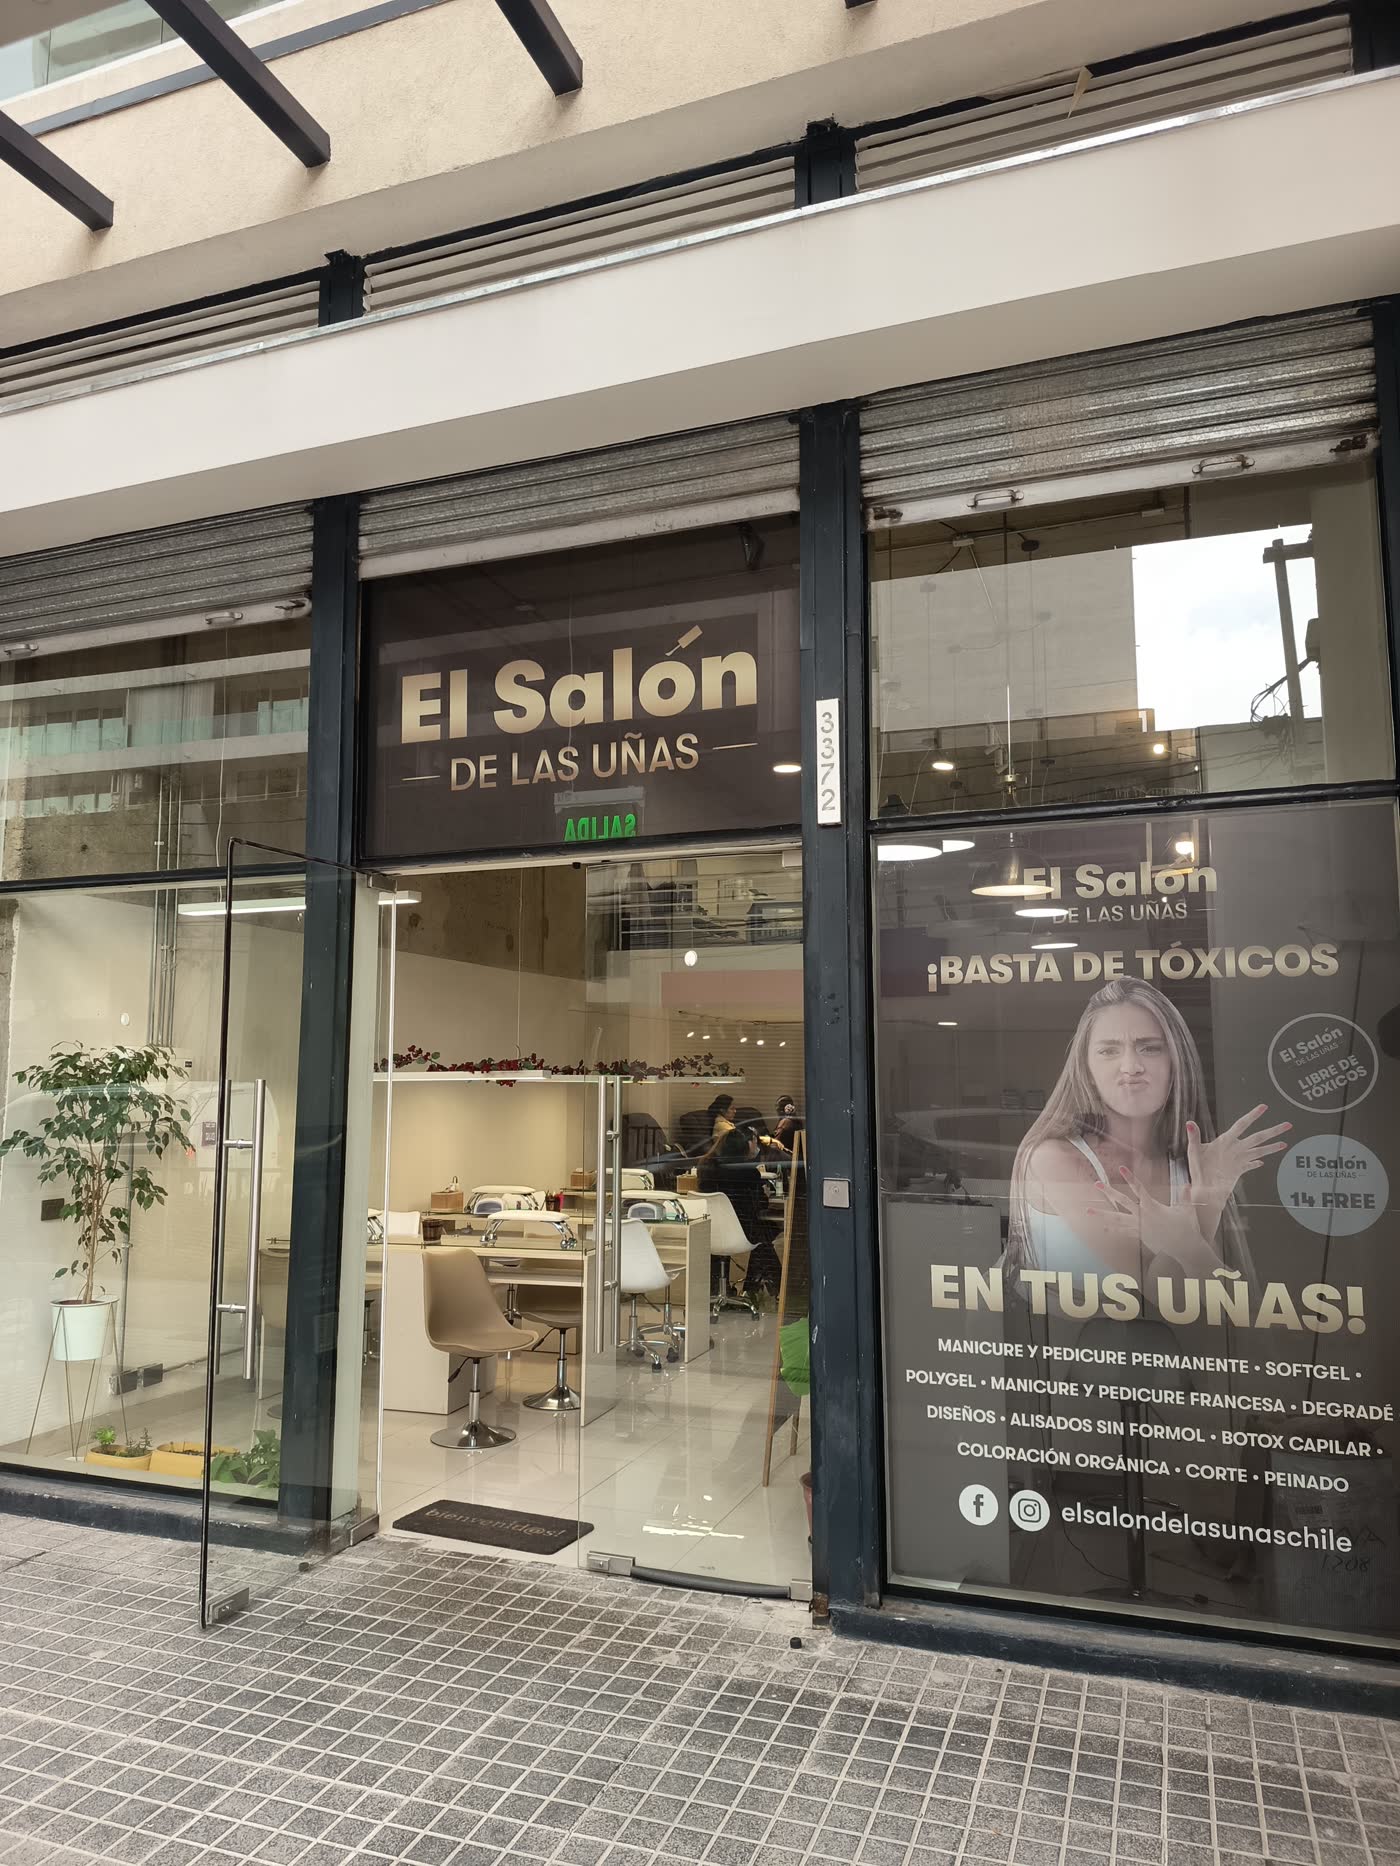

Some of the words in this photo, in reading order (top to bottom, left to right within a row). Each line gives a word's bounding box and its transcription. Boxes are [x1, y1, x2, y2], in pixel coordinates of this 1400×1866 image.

[401, 669, 468, 744] El
[493, 625, 758, 734] Salón
[450, 754, 498, 791] DE
[511, 746, 579, 786] LAS
[593, 732, 699, 778] UÑAS
[820, 711, 836, 812] 3372
[1024, 866, 1062, 900] El
[1086, 905, 1124, 923] LAS
[1130, 901, 1188, 921] UÑAS
[927, 953, 1062, 993] ¡BASTA
[1073, 950, 1124, 983] DE
[1135, 940, 1339, 980] TÓXICOS
[1279, 1047, 1297, 1063] El
[1296, 1027, 1343, 1054] Salón
[1295, 1057, 1306, 1066] DE
[1305, 1051, 1320, 1062] LAS
[1298, 1064, 1339, 1090] LIBRE
[1337, 1054, 1359, 1071] DE
[1302, 1065, 1368, 1101] TÓXICOS
[1295, 1156, 1311, 1169] El
[1315, 1155, 1367, 1170] Salón
[1336, 1170, 1357, 1179] UÑAS
[1290, 1192, 1315, 1208] 14
[1321, 1192, 1376, 1209] FREE
[930, 1264, 1003, 1312] EN
[1020, 1269, 1140, 1321] TUS
[1157, 1267, 1367, 1335] UÑAS!
[938, 1338, 1024, 1358] MANICURE
[1027, 1344, 1038, 1358] Y
[1042, 1345, 1127, 1366] PEDICURE
[1131, 1351, 1249, 1374] PERMANENTE
[1265, 1361, 1350, 1381] SOFTGEL
[905, 1369, 977, 1388] POLYGEL
[990, 1376, 1079, 1397] MANICURE
[1082, 1383, 1094, 1397] Y
[1098, 1385, 1185, 1405] PEDICURE
[1190, 1391, 1286, 1413] FRANCESA
[1302, 1400, 1394, 1422] DEGRADÉ
[927, 1404, 996, 1424] DISEÑOS
[1010, 1412, 1093, 1433] ALISADOS
[1096, 1420, 1124, 1436] SIN
[1129, 1422, 1205, 1443] FORMOL
[1221, 1430, 1284, 1449] BOTOX
[1289, 1436, 1371, 1457] CAPILAR
[957, 1441, 1071, 1466] COLORACIÓN
[1075, 1454, 1170, 1476] ORGÁNICA
[1185, 1463, 1247, 1483] CORTE
[1264, 1470, 1349, 1493] PEINADO
[1061, 1502, 1352, 1554] elsalondelasunaschile
